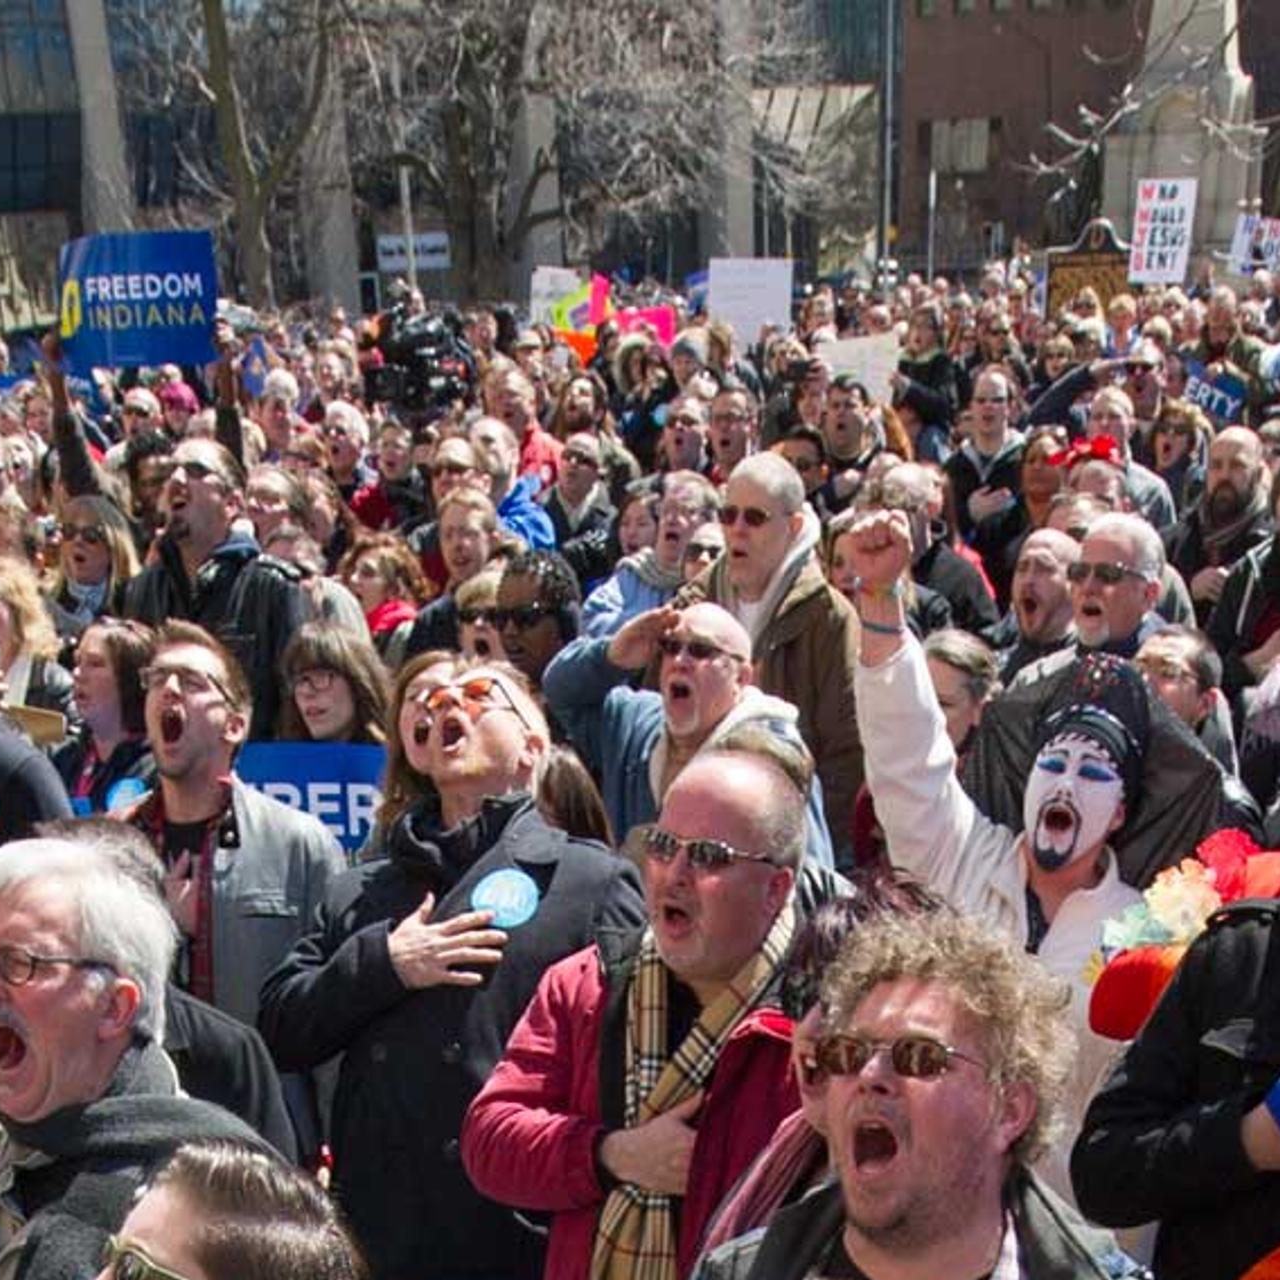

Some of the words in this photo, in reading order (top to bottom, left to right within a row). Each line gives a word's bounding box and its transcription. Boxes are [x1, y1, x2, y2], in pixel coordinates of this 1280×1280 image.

[85, 273, 204, 302] FREEDOM
[89, 302, 207, 330] INDIANA
[1184, 376, 1242, 418] ERTY
